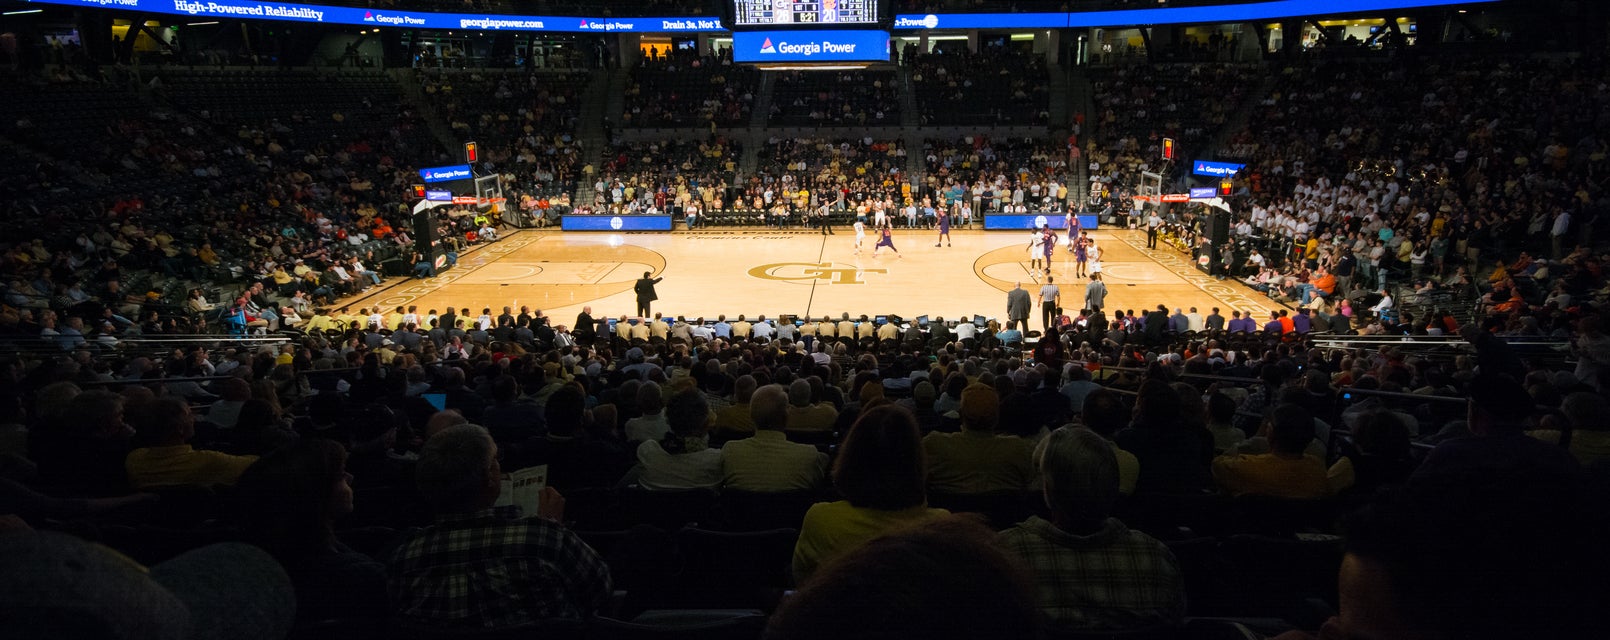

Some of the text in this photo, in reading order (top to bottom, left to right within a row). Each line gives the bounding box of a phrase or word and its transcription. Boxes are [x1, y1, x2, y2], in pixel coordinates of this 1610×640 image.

[174, 0, 324, 21] High-Powered Reliability
[822, 9, 836, 22] 20
[376, 14, 426, 25] Georgia Power
[460, 17, 544, 29] georgiapower.com
[662, 20, 685, 29] Drain
[686, 20, 698, 30] 3s,
[699, 20, 714, 29] Not
[590, 22, 634, 31] Georgia Power
[778, 41, 856, 56] Georgia Power
[1205, 166, 1225, 174] Georgia
